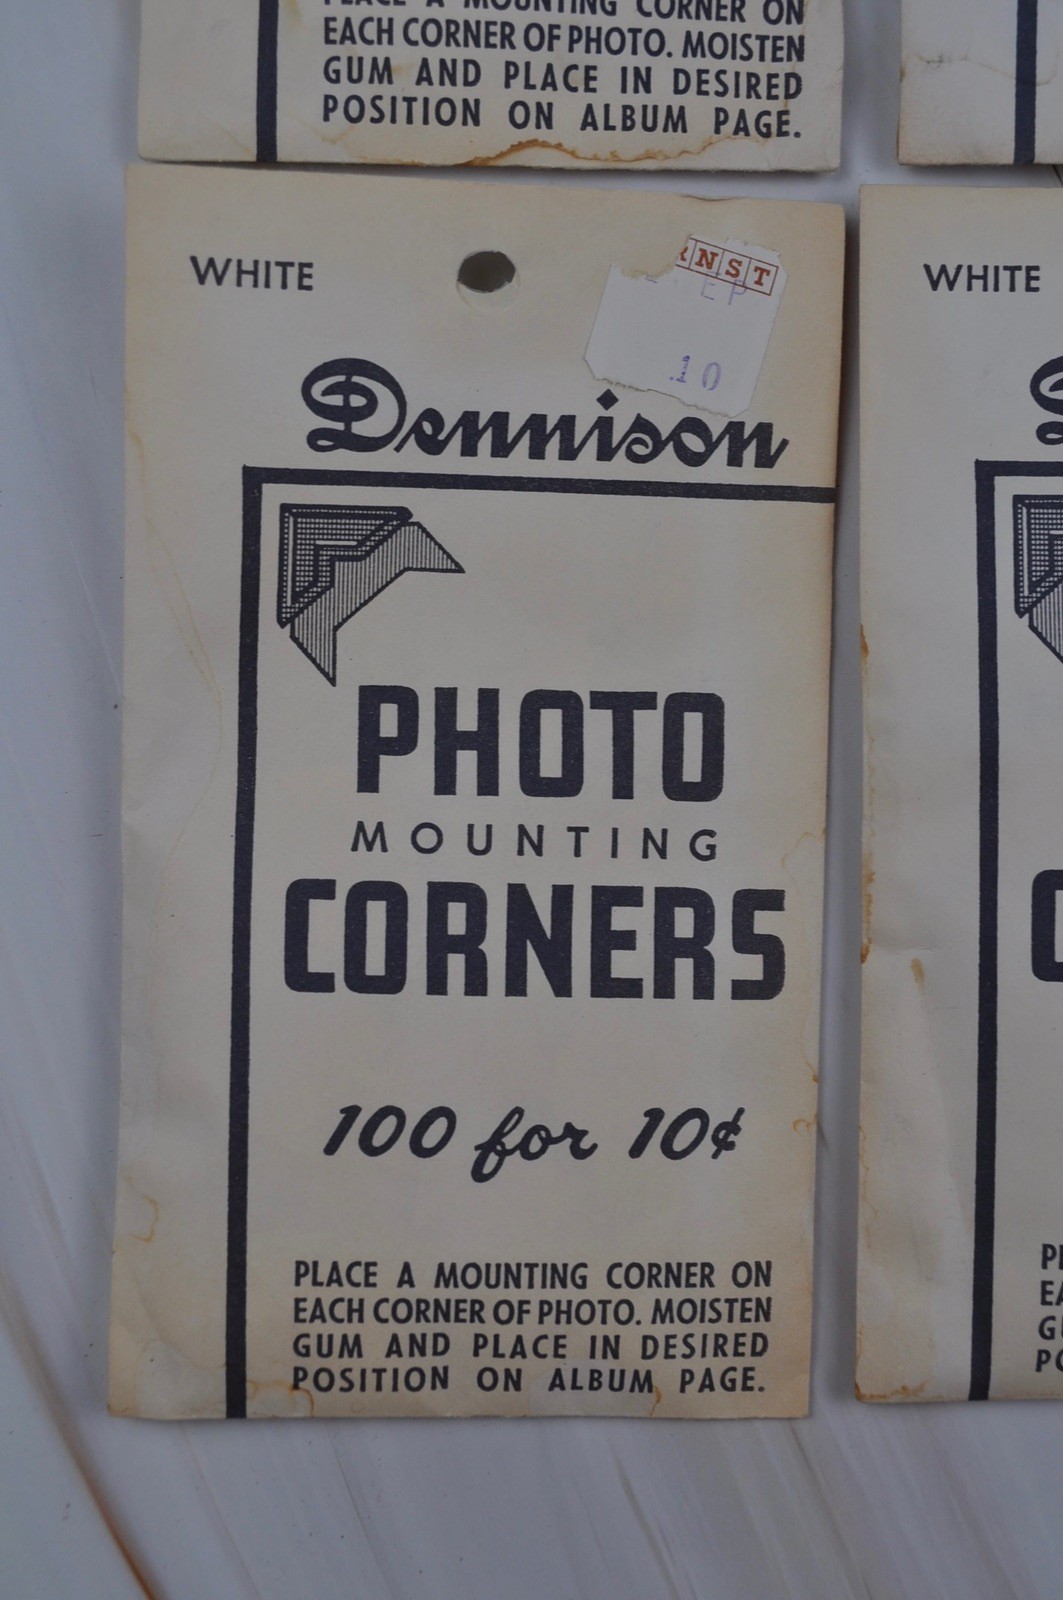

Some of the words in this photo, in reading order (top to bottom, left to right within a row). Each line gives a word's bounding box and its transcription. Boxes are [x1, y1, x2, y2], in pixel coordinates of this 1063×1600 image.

[763, 0, 805, 26] ON
[324, 16, 394, 46] EACH
[402, 17, 517, 50] CORNER
[523, 22, 561, 52] OF
[568, 25, 673, 58] PHOTO.
[682, 30, 805, 63] MOISTEN
[323, 55, 394, 85] GUM
[415, 57, 482, 87] AND
[504, 60, 598, 94] PLACE
[620, 66, 652, 95] IN
[673, 67, 803, 101] DESIRED
[322, 94, 481, 127] POSITION
[508, 100, 554, 131] ON
[579, 103, 688, 134] ALBUM
[713, 106, 801, 139] PAGE.
[189, 255, 314, 292] WHITE
[922, 263, 1041, 293] WHITE
[301, 357, 790, 469] Dennison
[356, 684, 725, 803] PHOTO
[350, 820, 718, 862] MOUNTING
[283, 878, 786, 1001] CORNERS
[323, 1104, 457, 1160] 100
[470, 1105, 599, 1184] for
[627, 1106, 746, 1161] 10¢
[294, 1260, 378, 1288] PLACE
[396, 1261, 416, 1289] A
[434, 1261, 589, 1290] MOUNTING
[606, 1260, 715, 1290] CORNER
[731, 1260, 773, 1289] ON
[293, 1297, 365, 1324] EACH
[372, 1297, 486, 1325] CORNER
[492, 1298, 531, 1326] OF
[537, 1299, 643, 1326] PHOTO.
[650, 1296, 773, 1325] MOISTEN
[292, 1332, 364, 1359] GUM
[384, 1332, 451, 1359] AND
[472, 1332, 567, 1360] PLACE
[589, 1334, 621, 1361] IN
[640, 1331, 769, 1361] DESIRED
[291, 1365, 449, 1393] POSITION
[476, 1366, 523, 1393] ON
[547, 1367, 655, 1394] ALBUM
[679, 1365, 765, 1393] PAGE.
